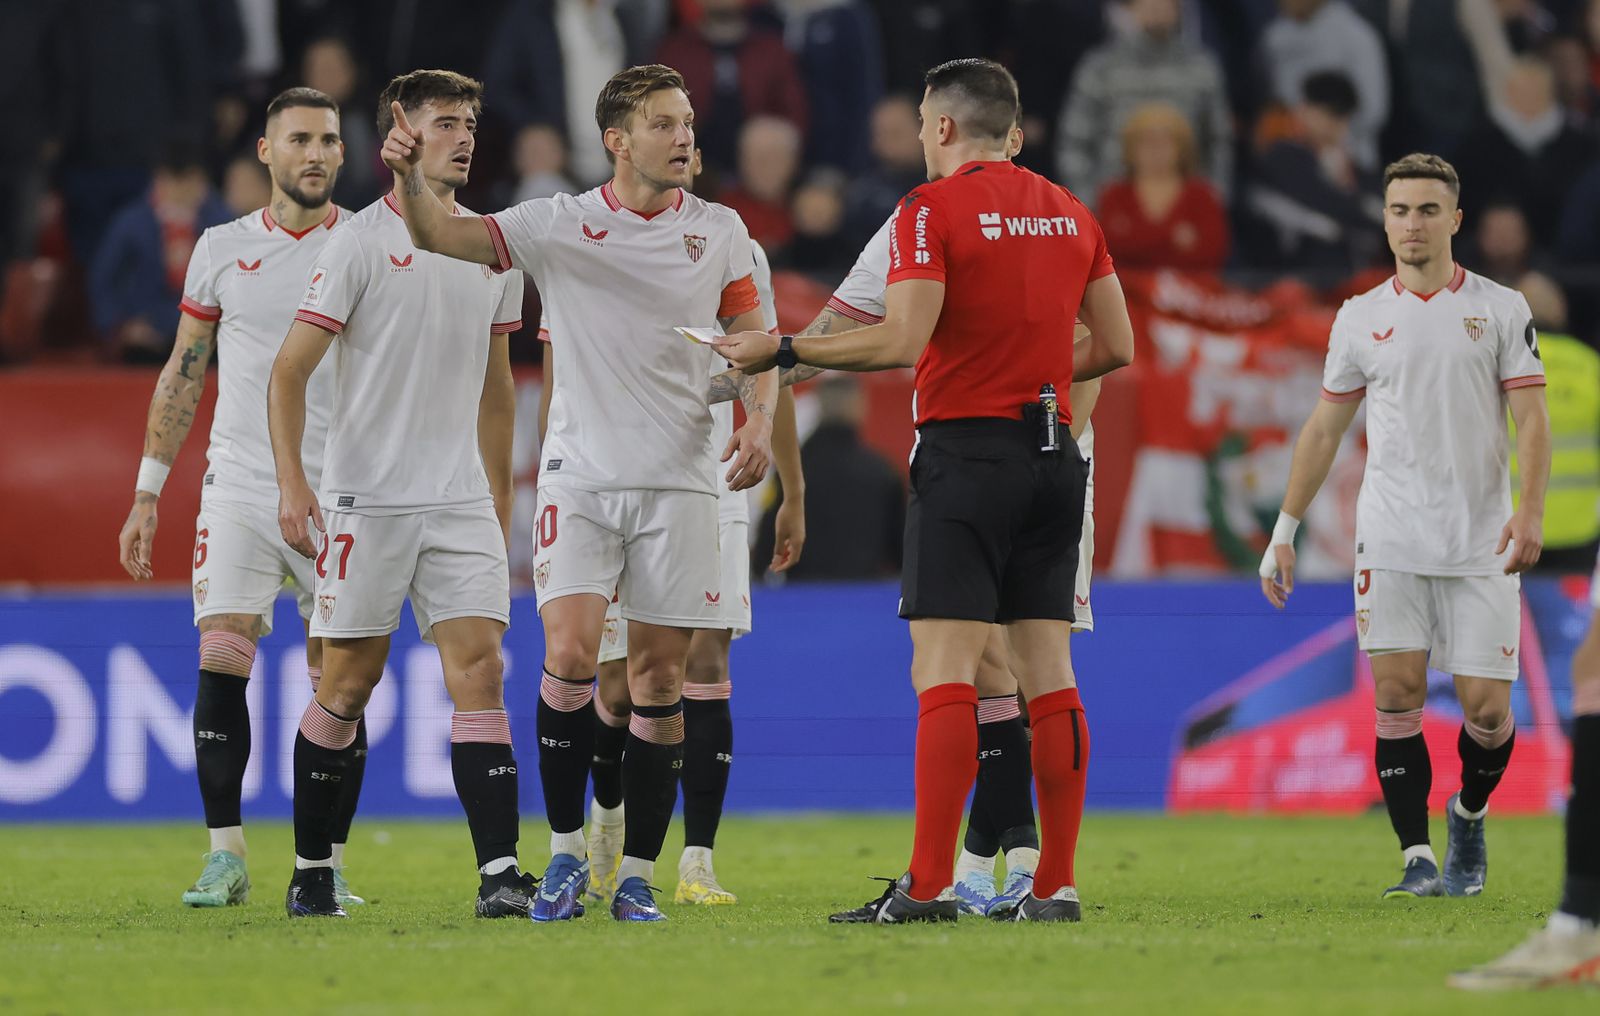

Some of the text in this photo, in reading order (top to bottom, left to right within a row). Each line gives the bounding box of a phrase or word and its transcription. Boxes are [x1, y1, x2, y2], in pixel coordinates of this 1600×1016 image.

[914, 205, 931, 249] WÜRTH
[1004, 216, 1078, 236] WÜRTH
[315, 532, 355, 580] 27
[198, 730, 228, 741] SFC
[541, 736, 571, 748] SFC
[979, 749, 1002, 759] FC
[311, 771, 342, 781] SFC
[488, 766, 517, 777] SFC
[1380, 767, 1406, 778] SFC
